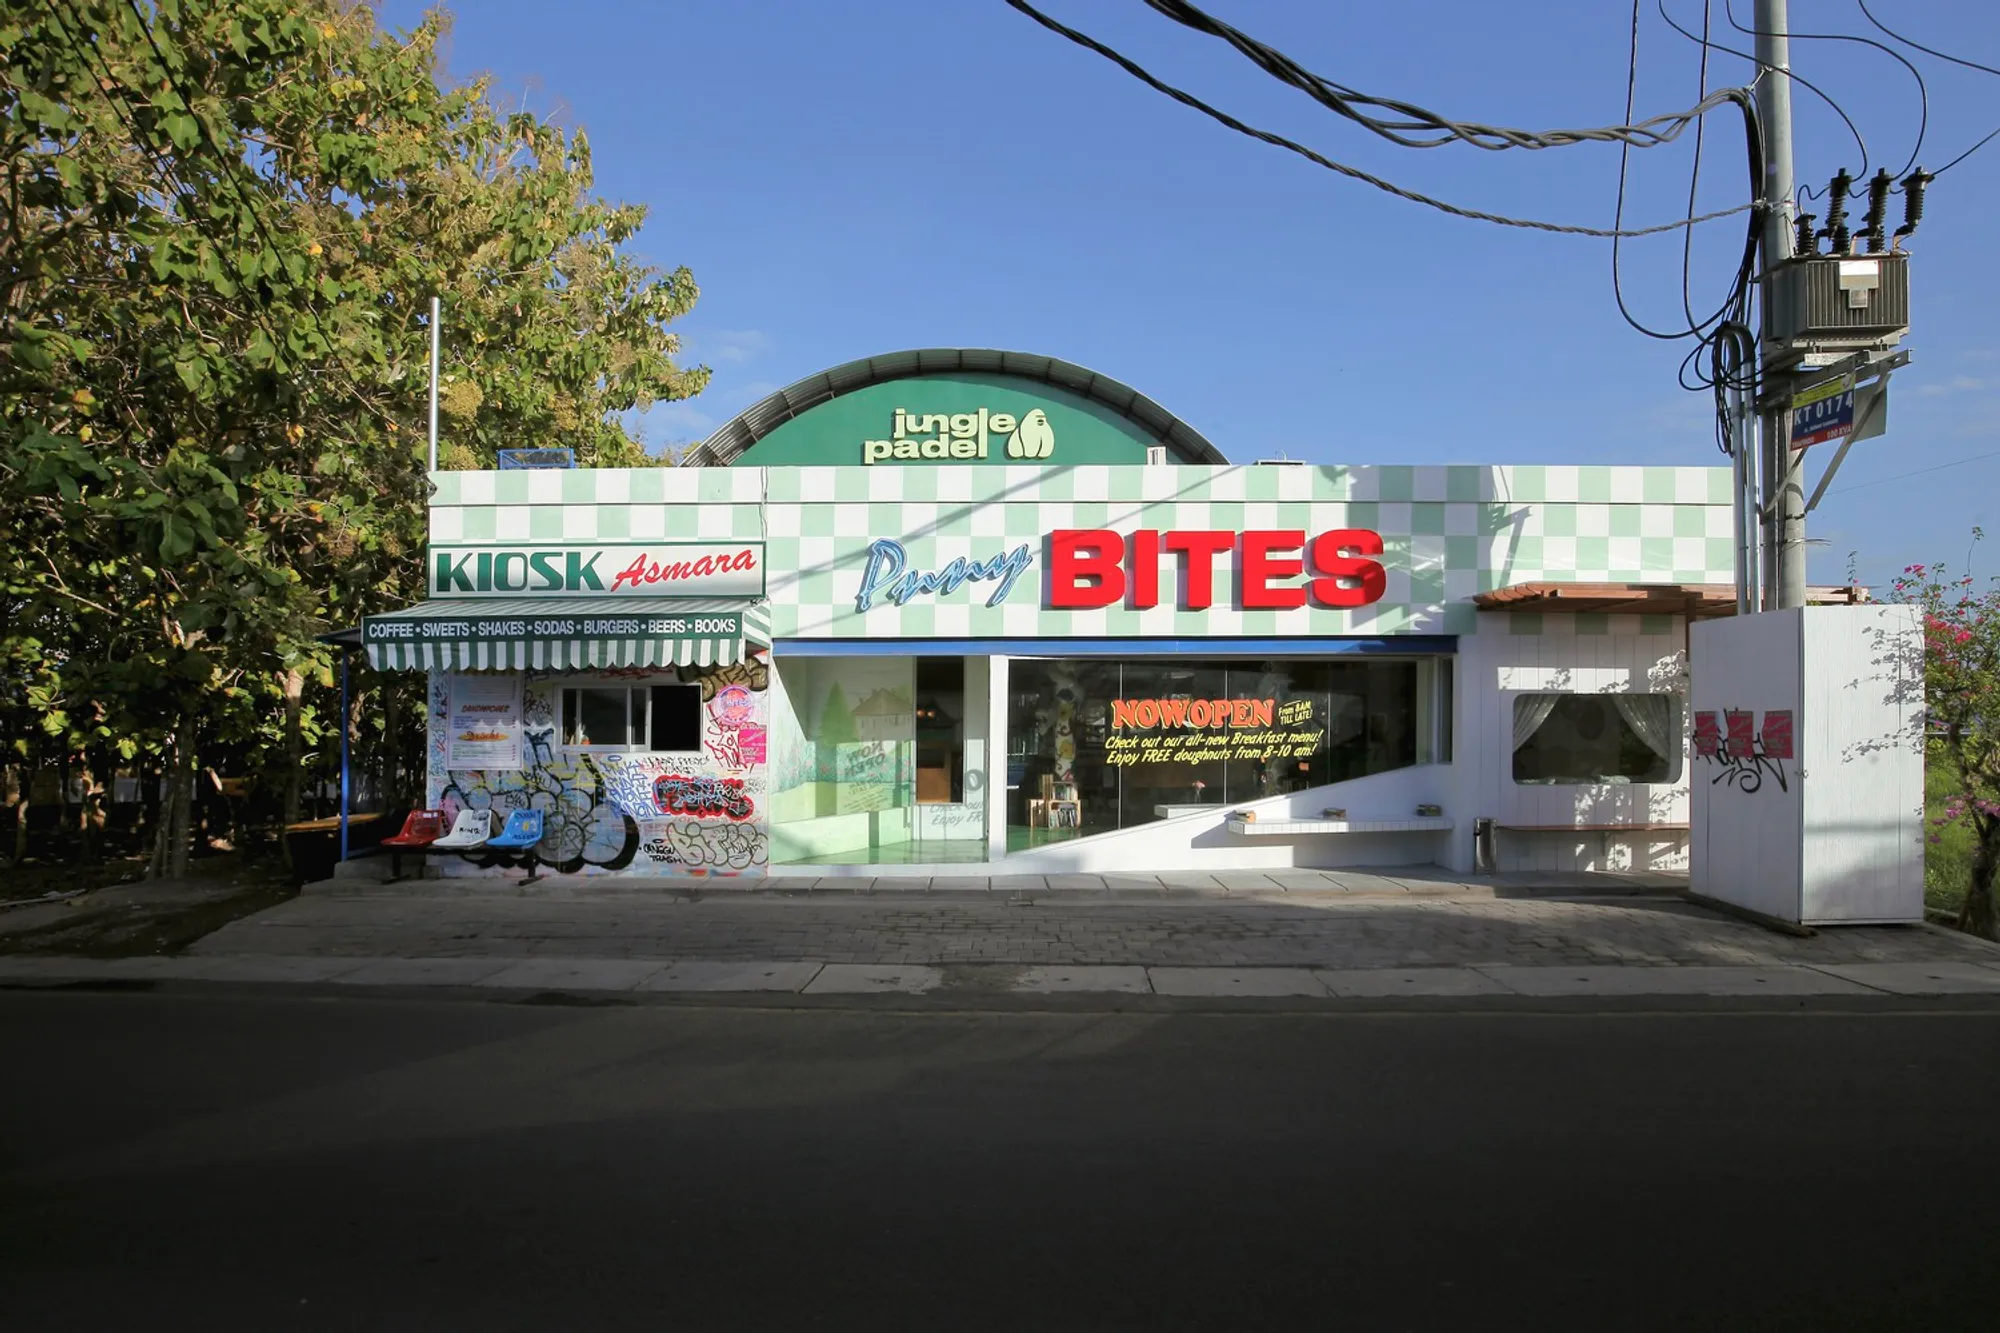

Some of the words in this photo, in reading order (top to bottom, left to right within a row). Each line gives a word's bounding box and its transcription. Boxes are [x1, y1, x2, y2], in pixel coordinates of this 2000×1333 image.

[893, 408, 1017, 438] jungle
[1794, 405, 1812, 426] KT
[1816, 391, 1854, 419] 0174
[863, 432, 988, 465] padel
[436, 551, 606, 592] KIOSK
[611, 549, 757, 592] Asmara
[1043, 529, 1387, 611] BITES
[369, 622, 414, 638] COFFEE
[422, 621, 469, 637] SWEETS
[478, 620, 525, 636] SHAKES
[533, 620, 574, 636] SODAS
[583, 619, 639, 635] BURGERS
[648, 618, 686, 634] BEERS
[694, 618, 736, 633] BOOKS
[1111, 699, 1189, 729] NOW
[1188, 698, 1275, 729] OPEN
[1278, 706, 1294, 717] From
[1294, 701, 1312, 712] 8AM
[1280, 713, 1294, 726] TILL
[1294, 709, 1313, 722] LATE!
[1105, 735, 1137, 749] Check
[1141, 736, 1160, 749] out
[1163, 736, 1184, 749] our
[1185, 732, 1230, 747] all-new
[1232, 731, 1287, 745] Breakfast
[1290, 729, 1325, 744] menu!
[1106, 751, 1140, 767] Enjoy
[1142, 750, 1171, 763] FREE
[1173, 748, 1231, 766] doughnuts
[1235, 747, 1262, 760] from
[1263, 746, 1292, 759] 8-10
[1294, 744, 1318, 757] am!
